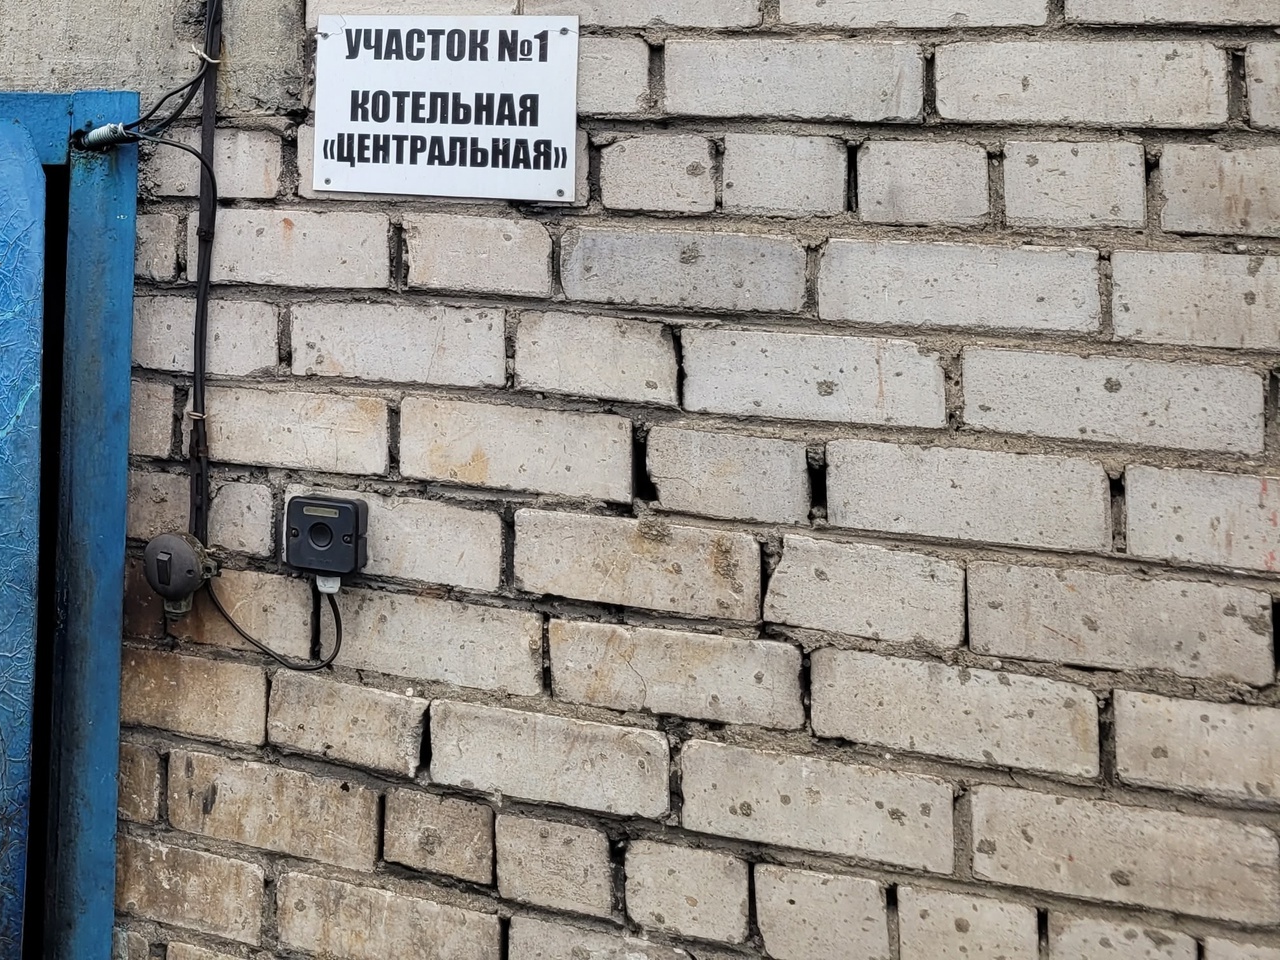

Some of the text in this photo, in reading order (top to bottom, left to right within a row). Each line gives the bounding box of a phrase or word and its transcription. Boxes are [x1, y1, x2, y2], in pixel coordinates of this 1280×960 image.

[345, 28, 548, 62] УЧАСТОК №1
[349, 90, 539, 127] КОТЕЛЬНАЯ
[323, 133, 568, 171] «ЦЕНТРАЛЬНАЯ»
